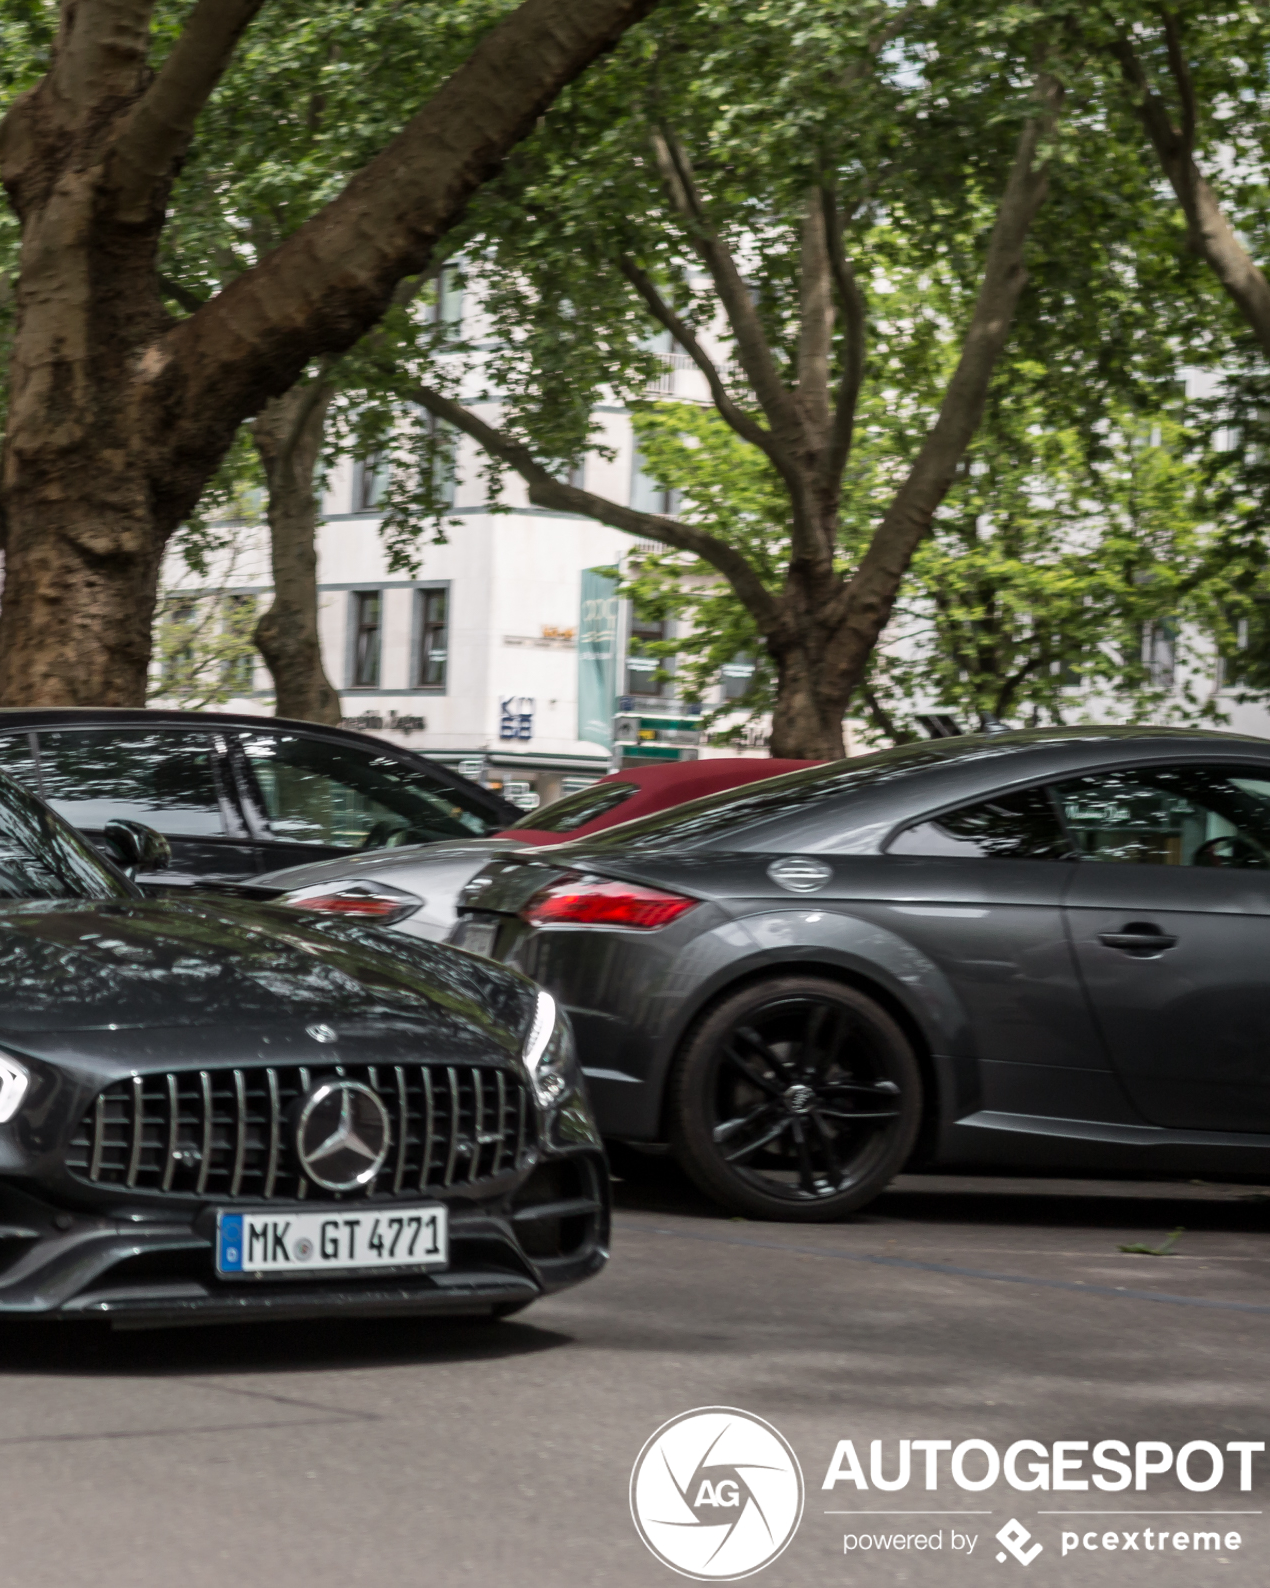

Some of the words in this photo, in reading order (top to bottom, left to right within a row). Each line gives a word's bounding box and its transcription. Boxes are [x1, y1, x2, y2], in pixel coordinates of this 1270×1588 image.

[249, 1221, 291, 1263] MK
[320, 1219, 361, 1260] GT
[368, 1215, 440, 1258] 4771
